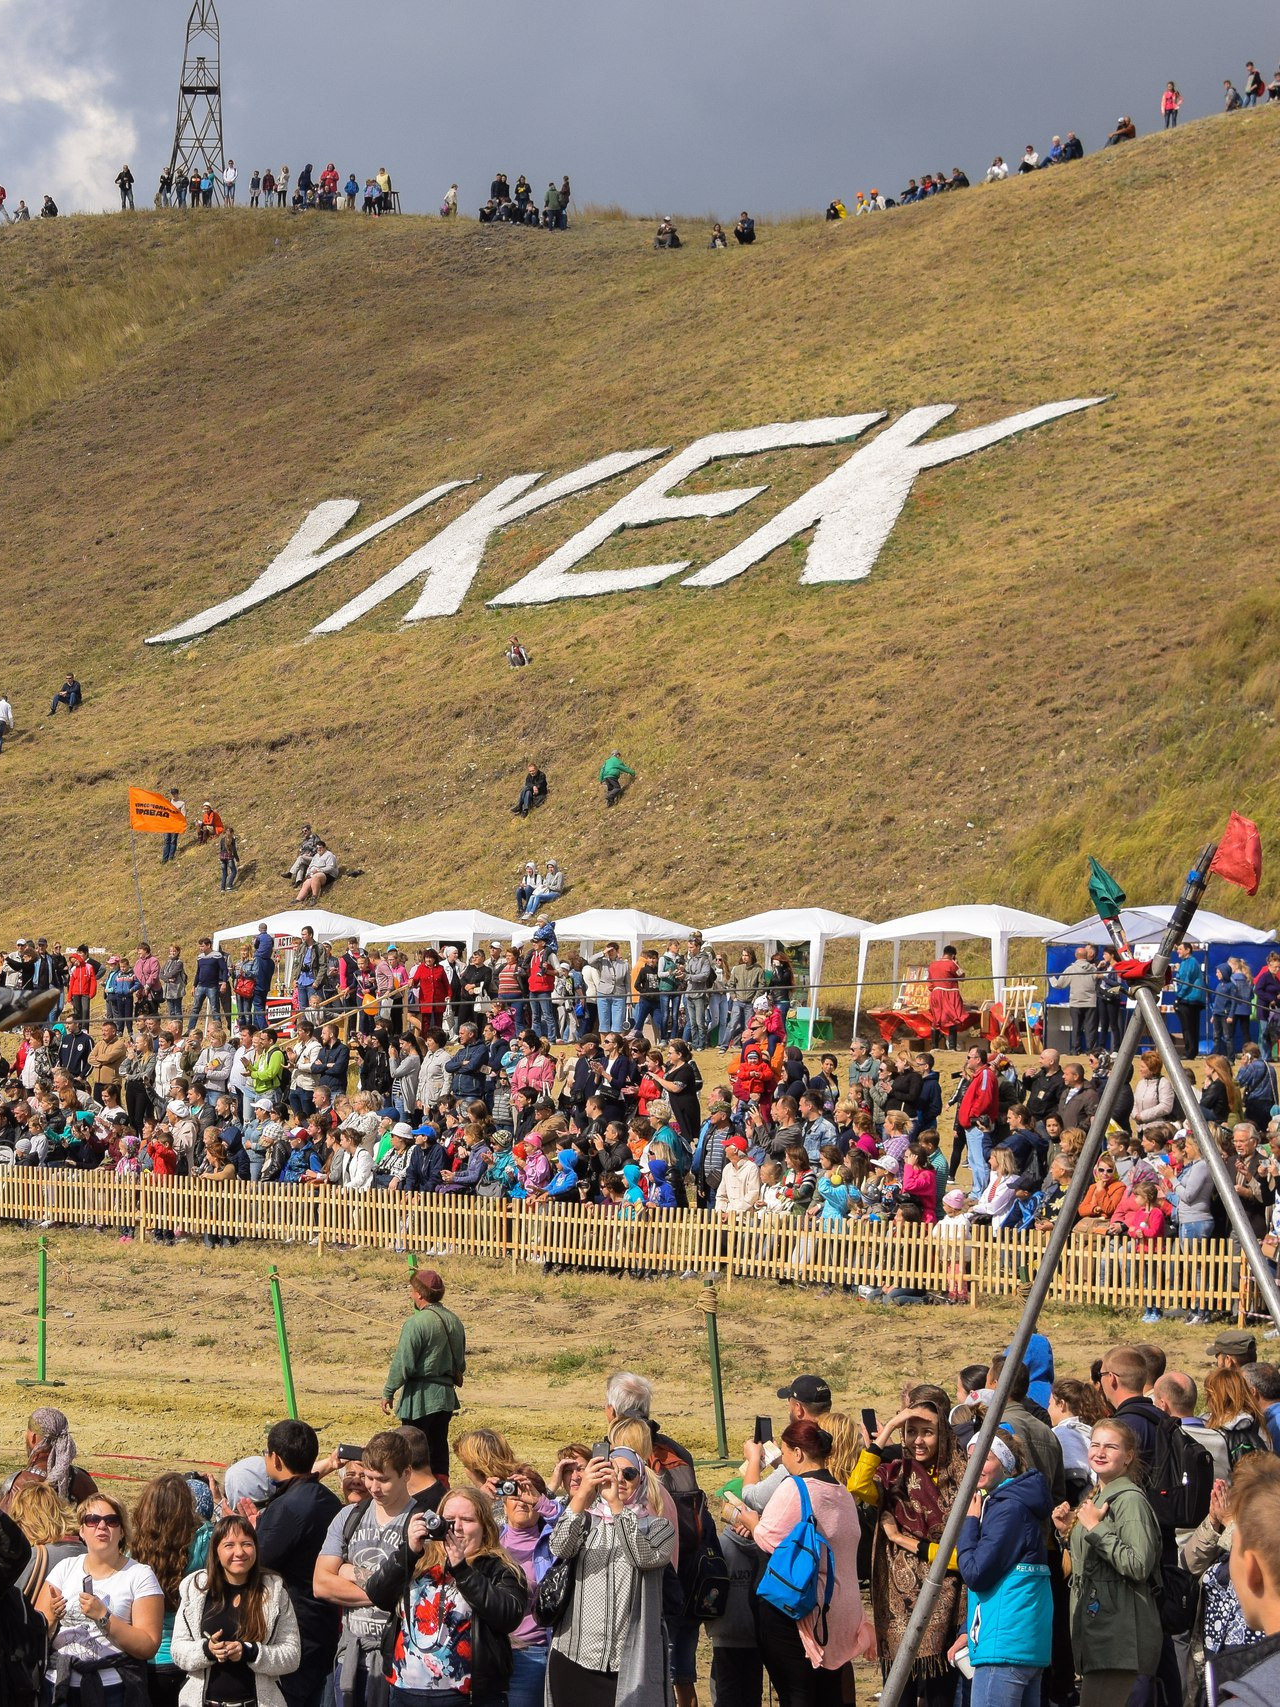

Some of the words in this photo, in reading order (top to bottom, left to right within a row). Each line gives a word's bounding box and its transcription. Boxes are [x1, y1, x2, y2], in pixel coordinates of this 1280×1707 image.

[144, 393, 1113, 645] УКЕК
[349, 1527, 380, 1546] ANTA
[383, 1528, 404, 1549] CRU
